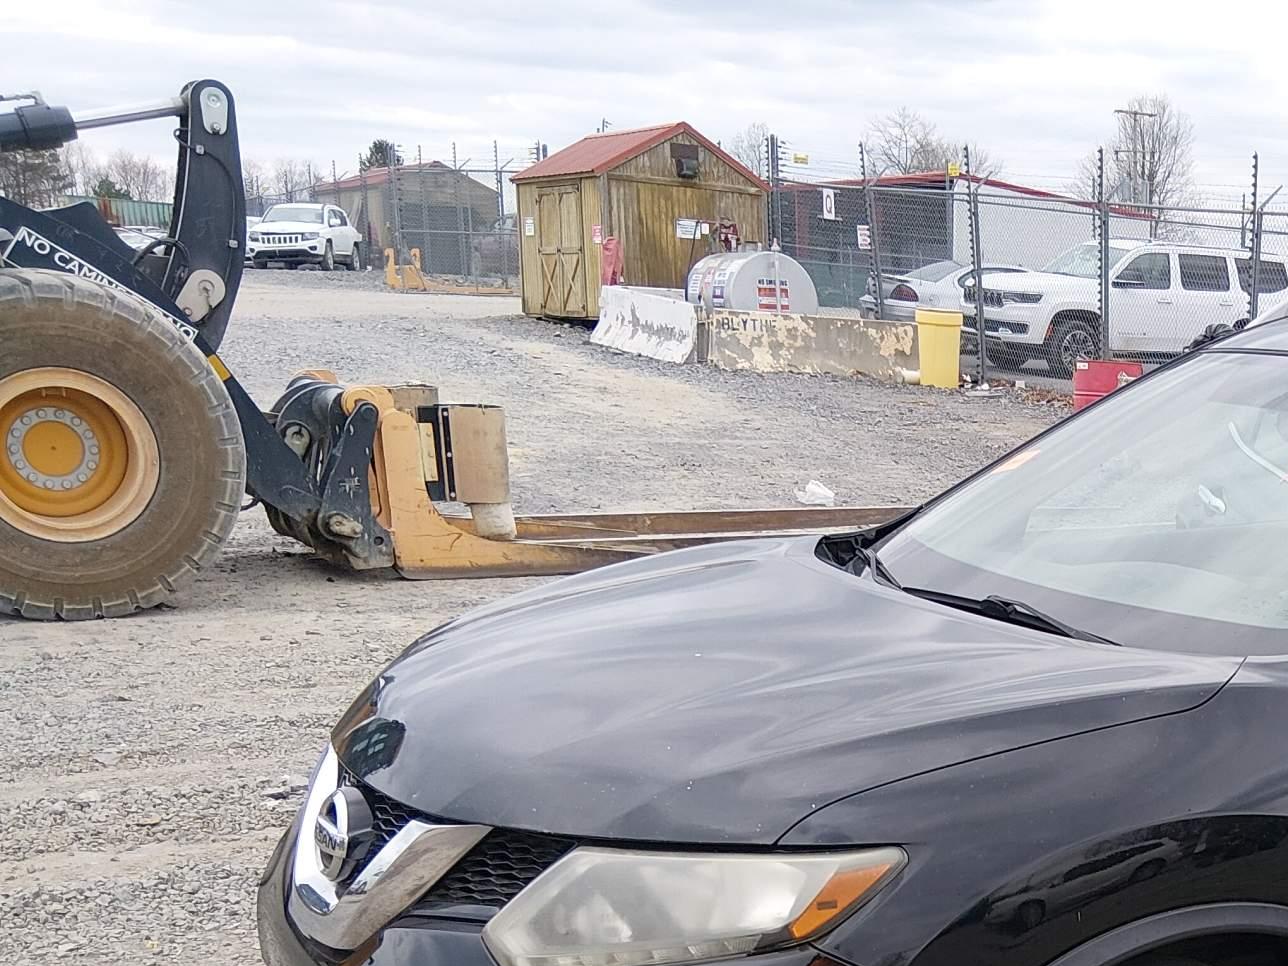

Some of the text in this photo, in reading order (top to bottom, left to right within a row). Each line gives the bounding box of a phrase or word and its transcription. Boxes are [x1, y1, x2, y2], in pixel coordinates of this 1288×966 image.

[825, 194, 833, 214] Q
[17, 229, 51, 255] NO
[766, 279, 788, 287] SMOING
